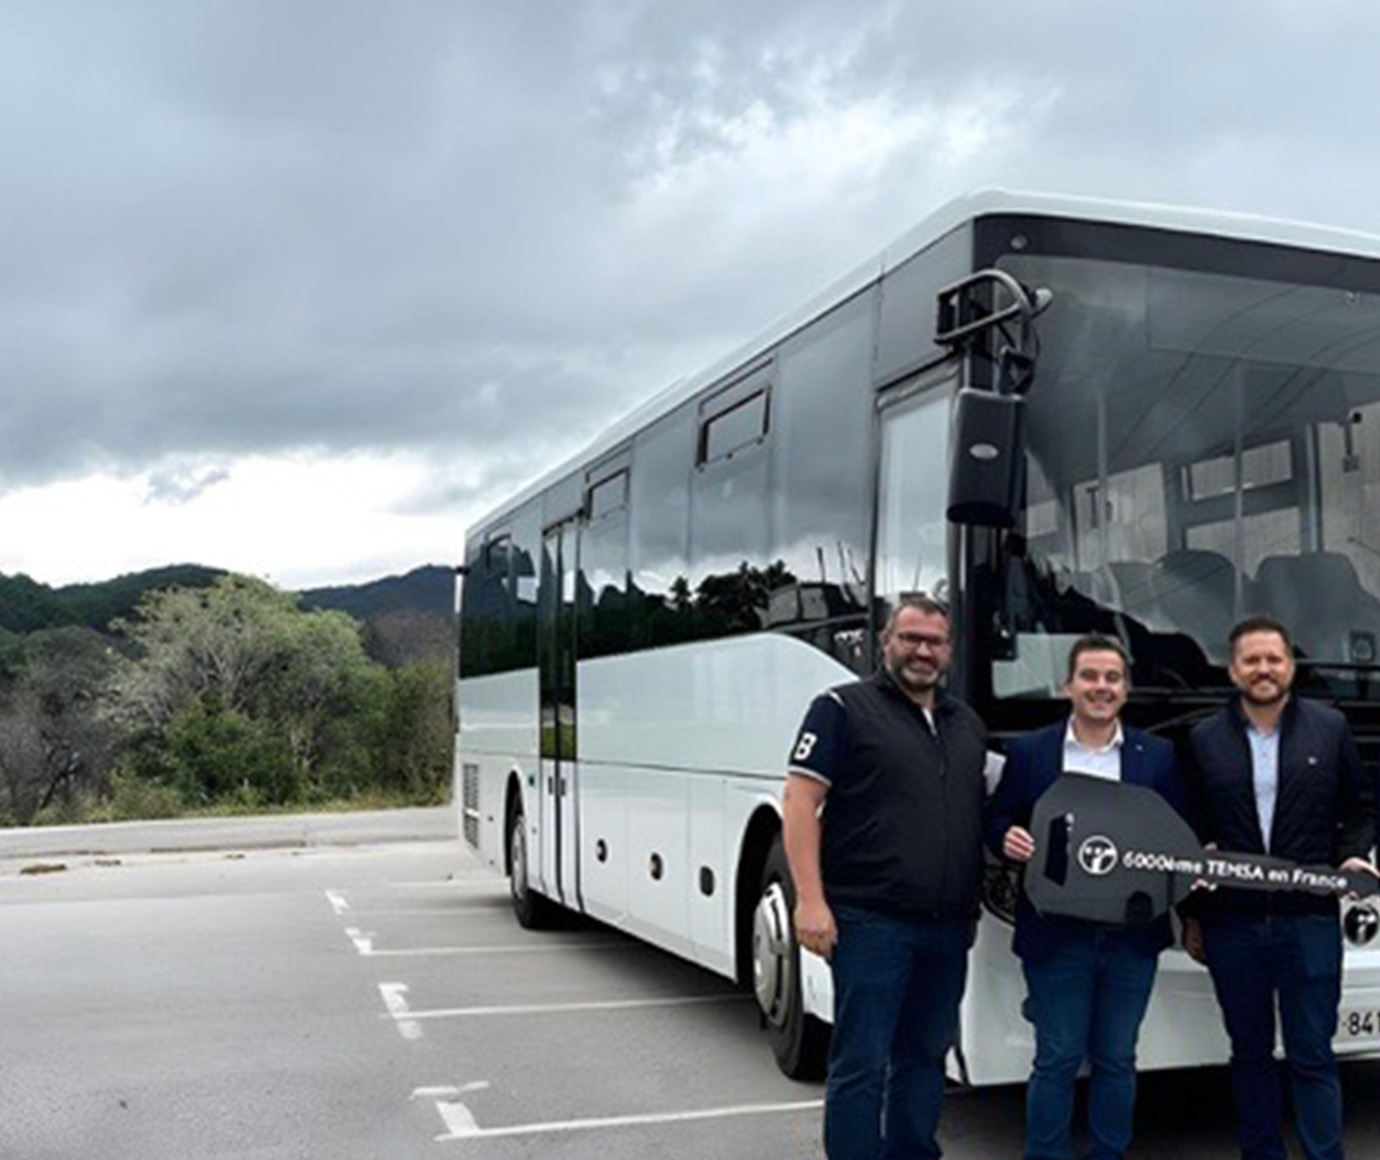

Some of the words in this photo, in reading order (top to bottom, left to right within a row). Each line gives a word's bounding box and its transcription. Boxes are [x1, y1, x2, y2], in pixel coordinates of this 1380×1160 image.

[794, 732, 818, 760] B
[1206, 859, 1264, 881] TEMSA
[1268, 868, 1289, 884] en
[1292, 868, 1348, 890] France
